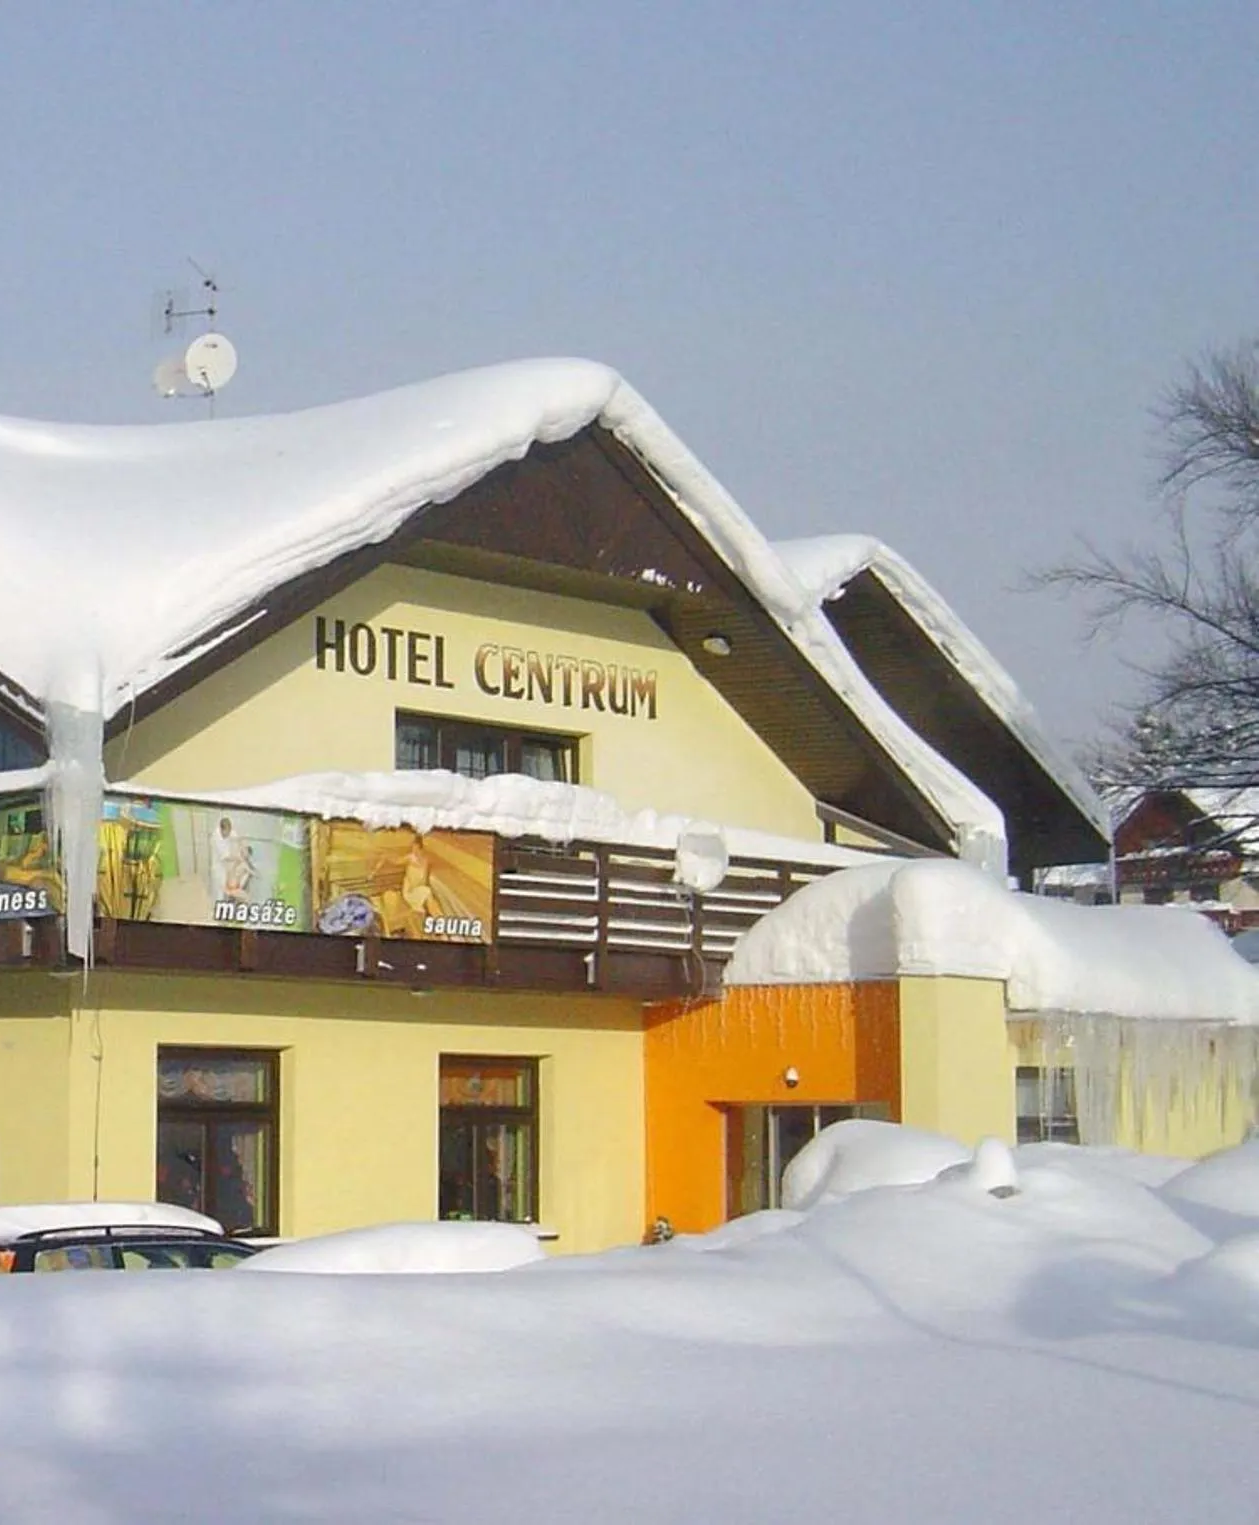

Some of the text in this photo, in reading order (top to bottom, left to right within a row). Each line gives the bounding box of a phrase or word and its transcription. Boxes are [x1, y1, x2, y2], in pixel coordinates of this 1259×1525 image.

[315, 615, 658, 720] HOTEL CENTRUM
[214, 898, 299, 925] masáže
[423, 914, 483, 937] sauna
